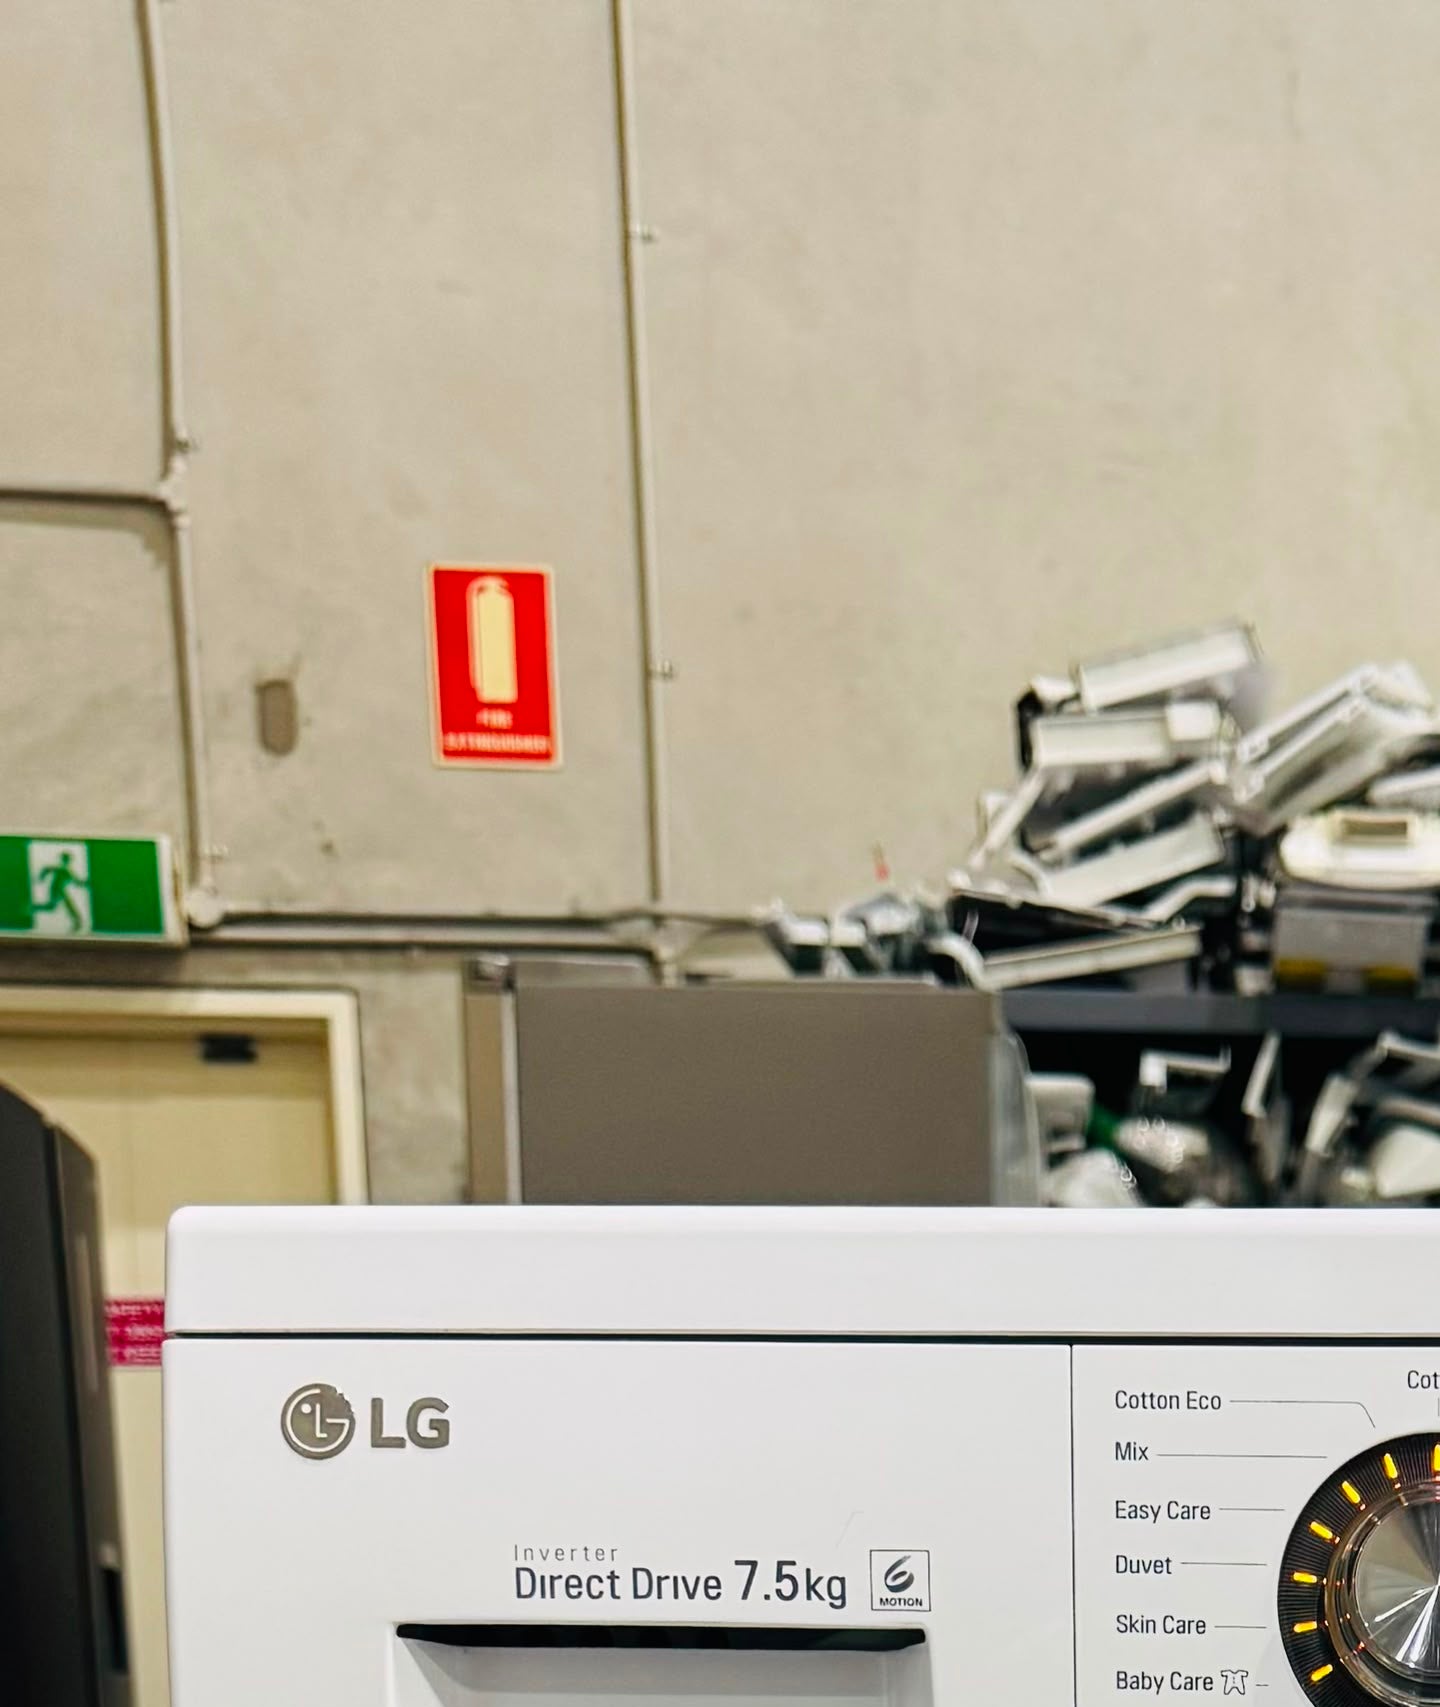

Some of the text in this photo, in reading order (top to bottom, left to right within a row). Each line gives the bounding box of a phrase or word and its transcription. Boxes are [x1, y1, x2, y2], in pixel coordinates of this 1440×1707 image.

[1115, 1390, 1222, 1411] Cotton Eco
[370, 1396, 451, 1450] LG
[1115, 1441, 1150, 1462] Mix
[1115, 1500, 1211, 1525] Easy Care
[514, 1544, 618, 1562] Inverter
[1115, 1554, 1172, 1576] Duvet
[514, 1559, 847, 1610] Direct Drive 7.5kg
[880, 1597, 923, 1608] MOTION
[1115, 1614, 1207, 1636] Skin Care
[1115, 1671, 1215, 1696] Baby Care
